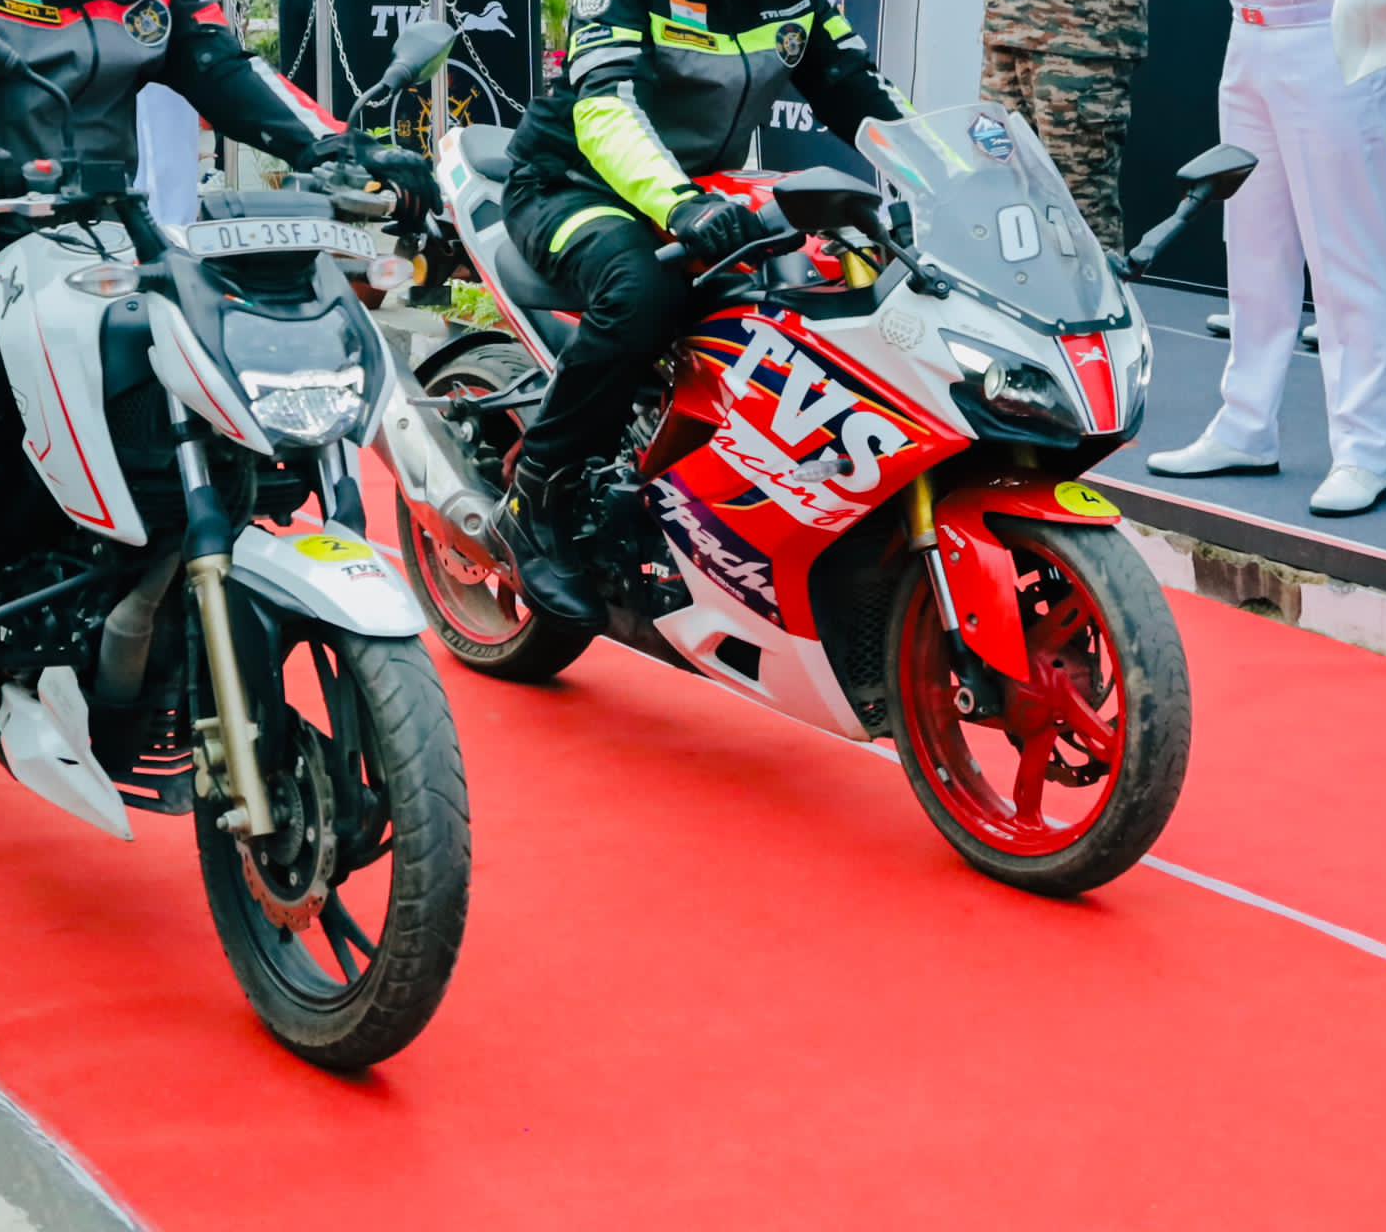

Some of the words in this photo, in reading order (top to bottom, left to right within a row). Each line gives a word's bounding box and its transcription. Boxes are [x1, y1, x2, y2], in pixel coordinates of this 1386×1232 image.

[371, 5, 431, 37] TV
[770, 100, 813, 132] TVS
[720, 318, 909, 493] TVS
